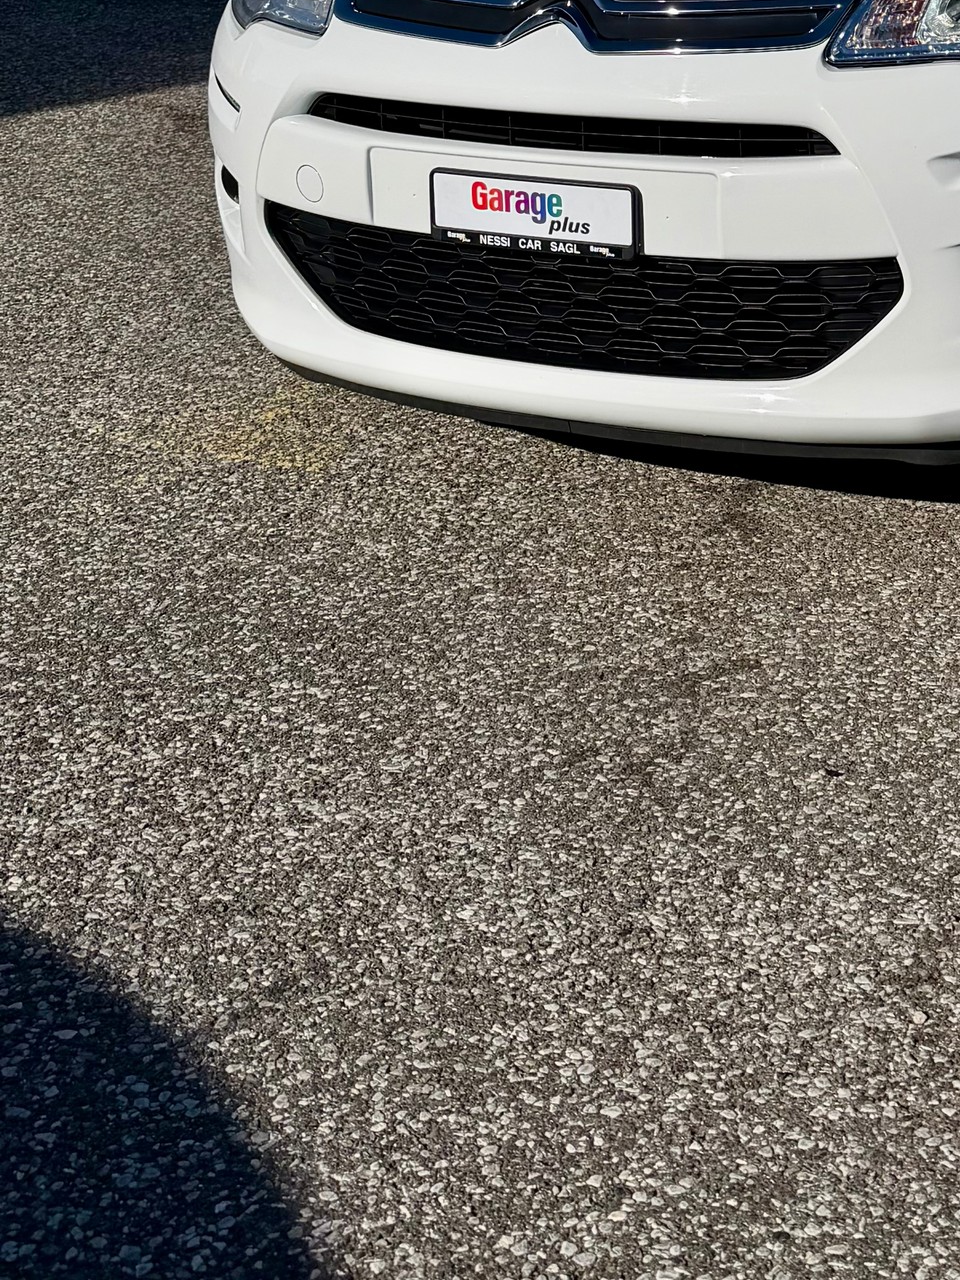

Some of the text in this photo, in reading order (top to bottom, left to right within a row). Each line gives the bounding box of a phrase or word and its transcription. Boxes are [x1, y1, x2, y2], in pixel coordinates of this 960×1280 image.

[471, 181, 563, 225] Garage
[548, 217, 591, 235] plus
[479, 234, 581, 255] NESSI CAR SAGL
